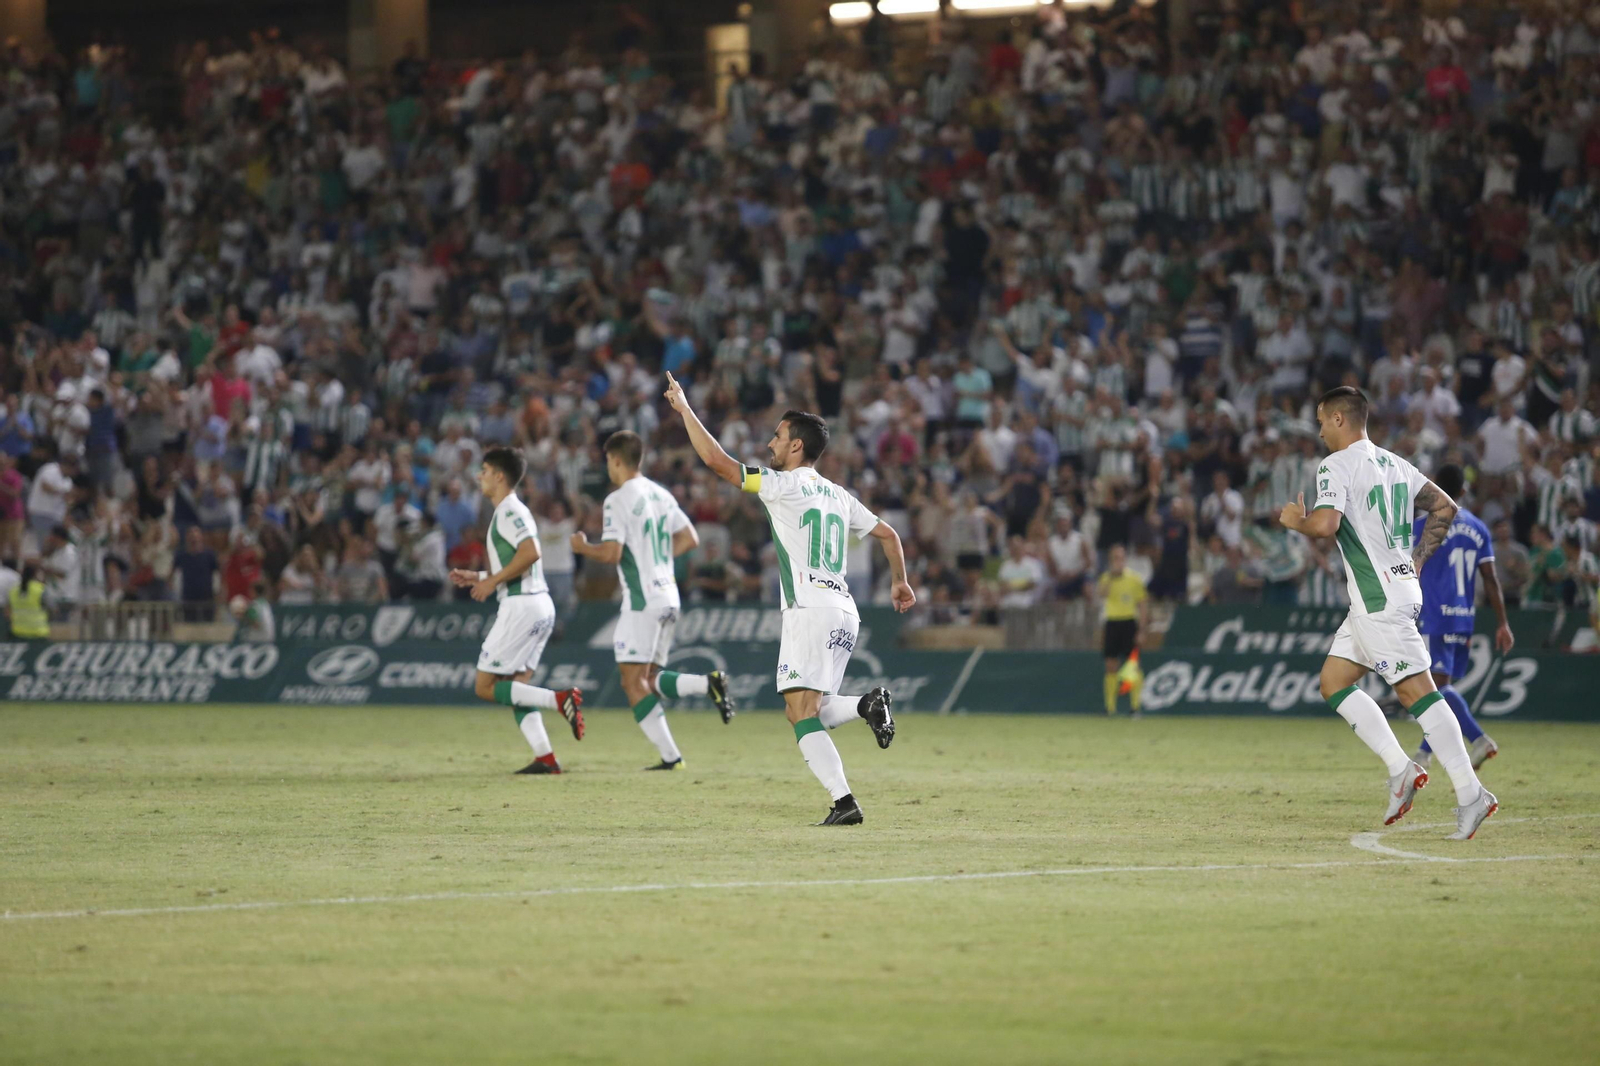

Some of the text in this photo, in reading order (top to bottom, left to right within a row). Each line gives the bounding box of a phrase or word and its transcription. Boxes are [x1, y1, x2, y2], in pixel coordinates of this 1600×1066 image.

[642, 513, 670, 566] 16
[799, 507, 845, 575] 10
[1366, 482, 1412, 550] 14
[1448, 547, 1478, 598] 11
[0, 642, 280, 680] EL CHURRASCO
[1187, 661, 1328, 711] LaLiga
[8, 675, 216, 702] RESTAURANTE
